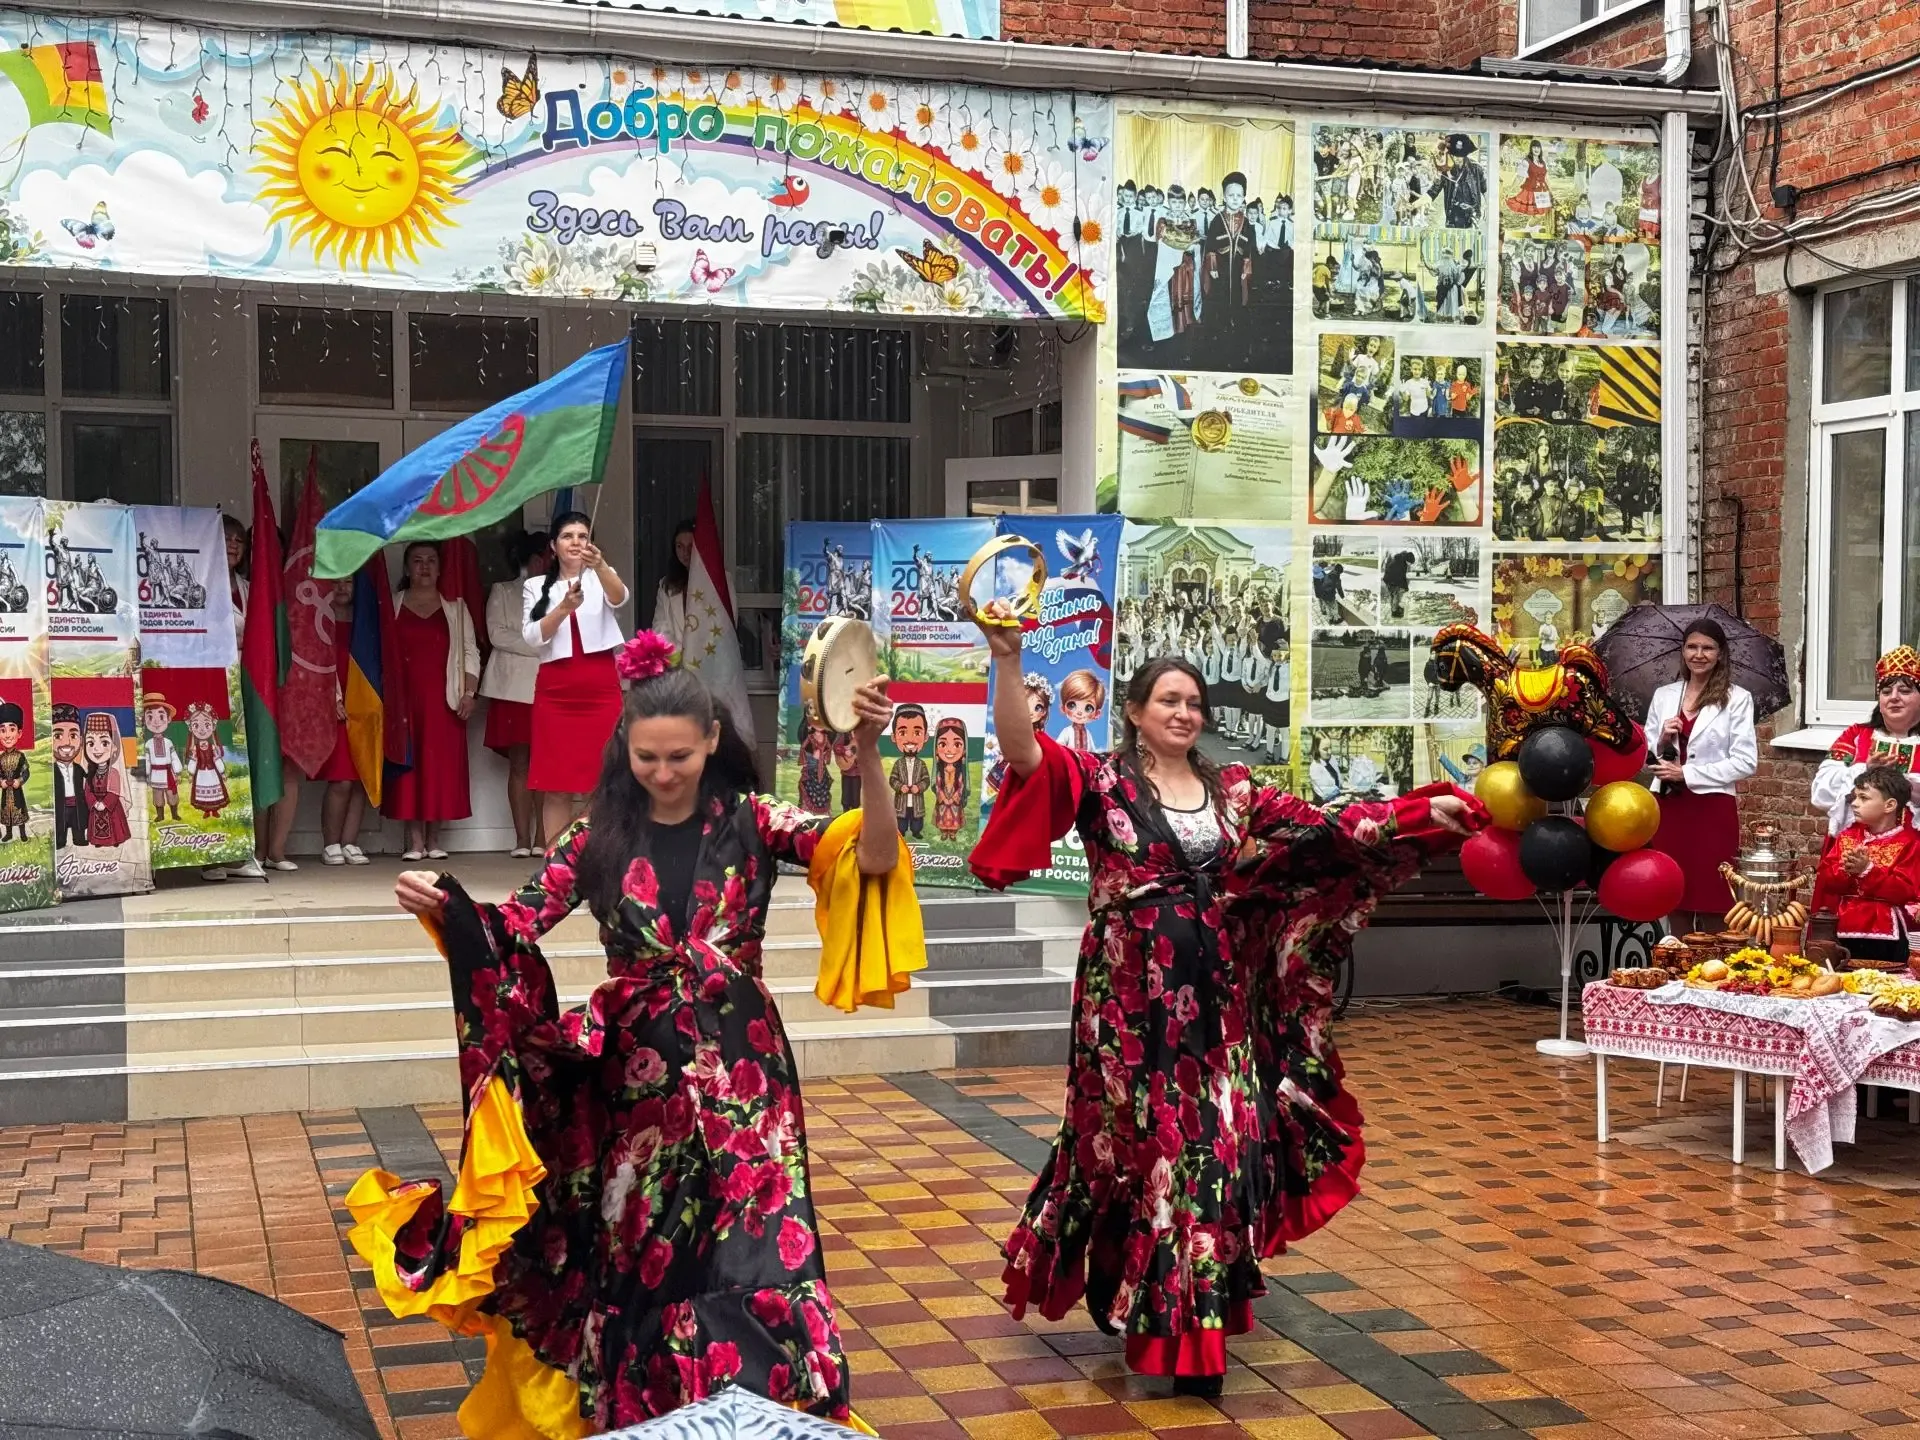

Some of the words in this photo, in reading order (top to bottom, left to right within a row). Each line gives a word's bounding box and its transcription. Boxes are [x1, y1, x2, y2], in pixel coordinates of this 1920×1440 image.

[542, 86, 725, 154] Добро
[754, 115, 1078, 300] пожаловать!
[526, 189, 644, 245] Здесь
[653, 198, 754, 243] Вам
[801, 561, 828, 587] 20
[891, 567, 919, 591] 20
[799, 586, 828, 612] 26
[891, 592, 919, 616] 26
[1039, 594, 1102, 625] сильна,
[143, 611, 182, 619] ЕДИНСТВА
[72, 626, 104, 634] РОССИИ
[891, 625, 906, 633] ГОД
[908, 625, 949, 633] ЕДИНСТВА
[891, 633, 927, 641] НАРОДОВ
[930, 634, 961, 642] РОССИИ
[1043, 618, 1103, 664] едина!
[56, 854, 120, 886] Армяне
[1045, 868, 1090, 882] РОССИ
